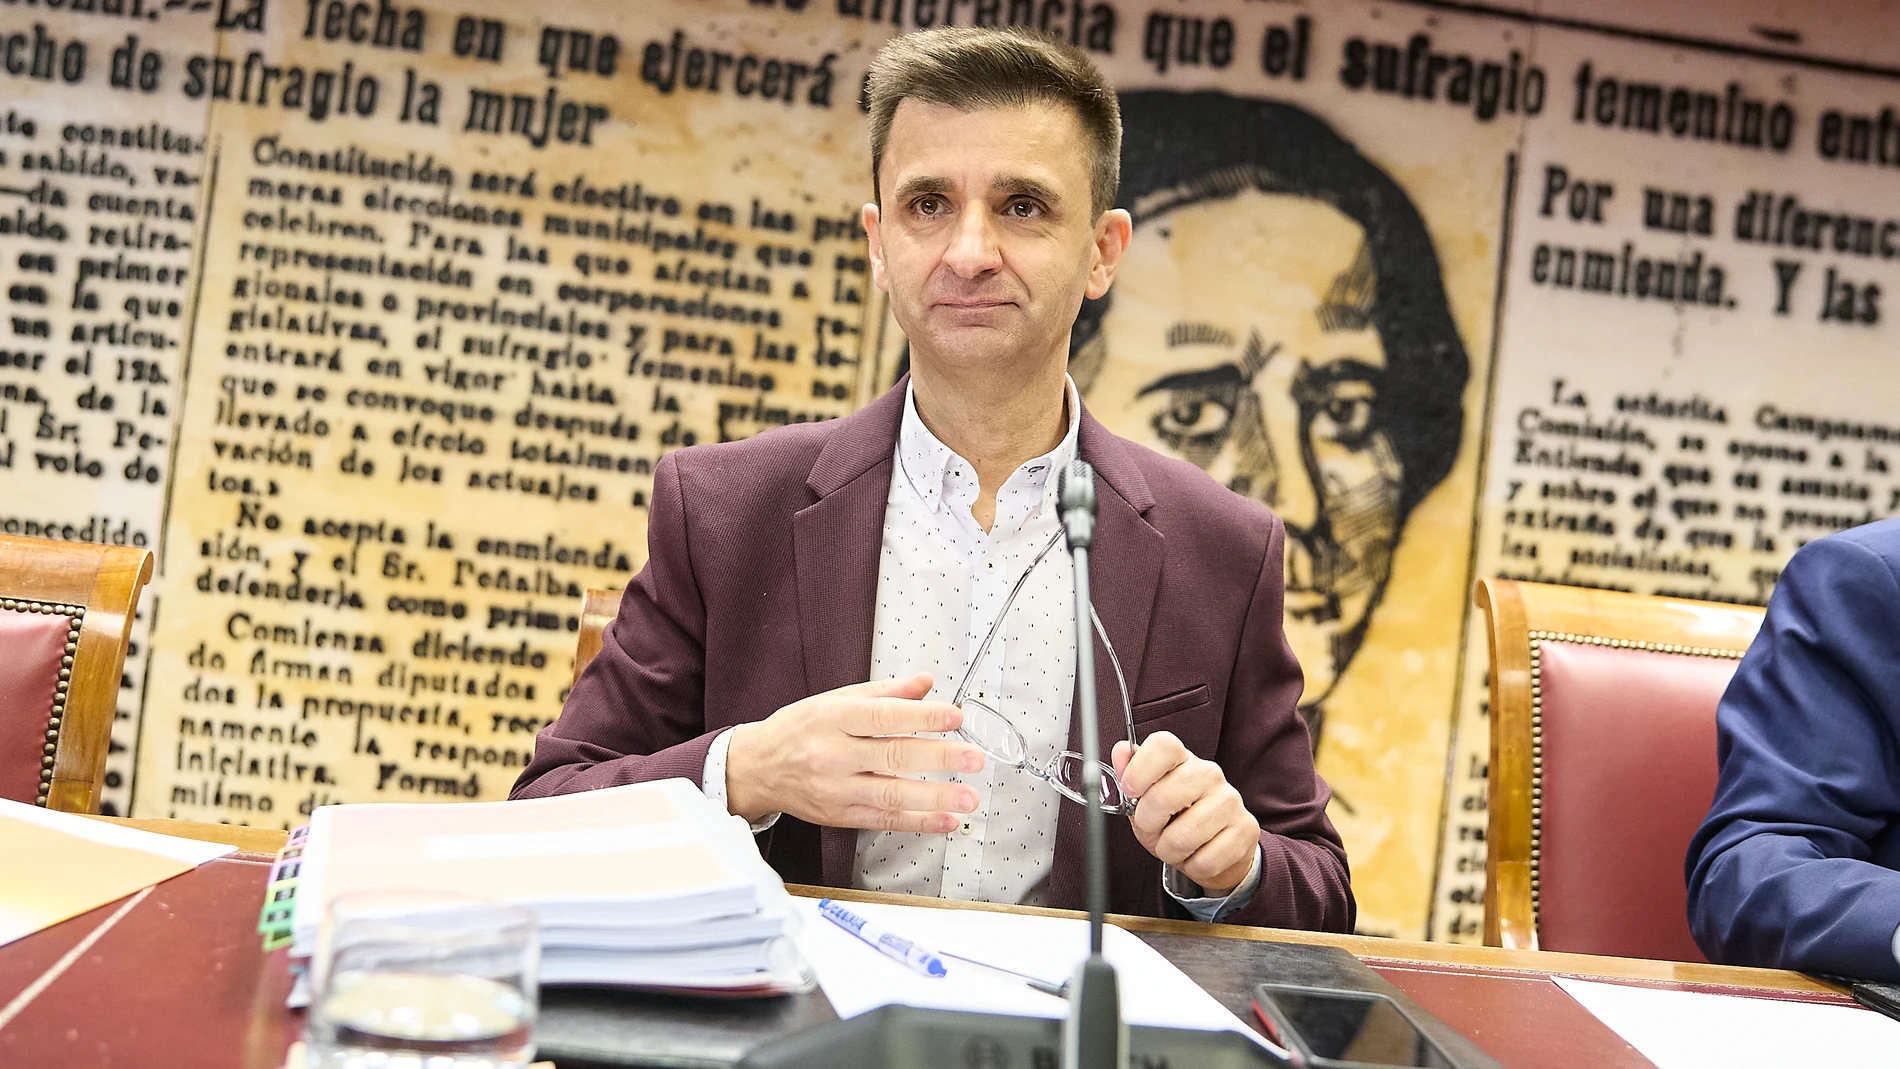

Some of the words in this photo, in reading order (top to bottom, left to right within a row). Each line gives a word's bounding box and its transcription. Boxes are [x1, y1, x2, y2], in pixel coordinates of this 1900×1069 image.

[110, 34, 162, 92] de
[183, 50, 379, 121] sufragio
[401, 68, 441, 125] la
[454, 14, 505, 62] en
[539, 26, 620, 80] que
[640, 28, 838, 108] ejercerá
[1144, 10, 1235, 75] que
[1264, 15, 1311, 80] el
[1340, 33, 1547, 120] sufragio
[1573, 60, 1797, 155] femenino
[253, 134, 453, 186] Constitución
[753, 198, 798, 233] las
[1540, 162, 1613, 225] Por
[1643, 185, 1715, 236] una
[76, 252, 189, 286] primer
[408, 219, 482, 256] Para
[1531, 240, 1736, 309] enmienda.
[1772, 259, 1802, 316] Y
[1820, 267, 1881, 325] las
[140, 390, 166, 417] la
[236, 499, 281, 532] No
[427, 520, 453, 551] la
[332, 548, 358, 577] el
